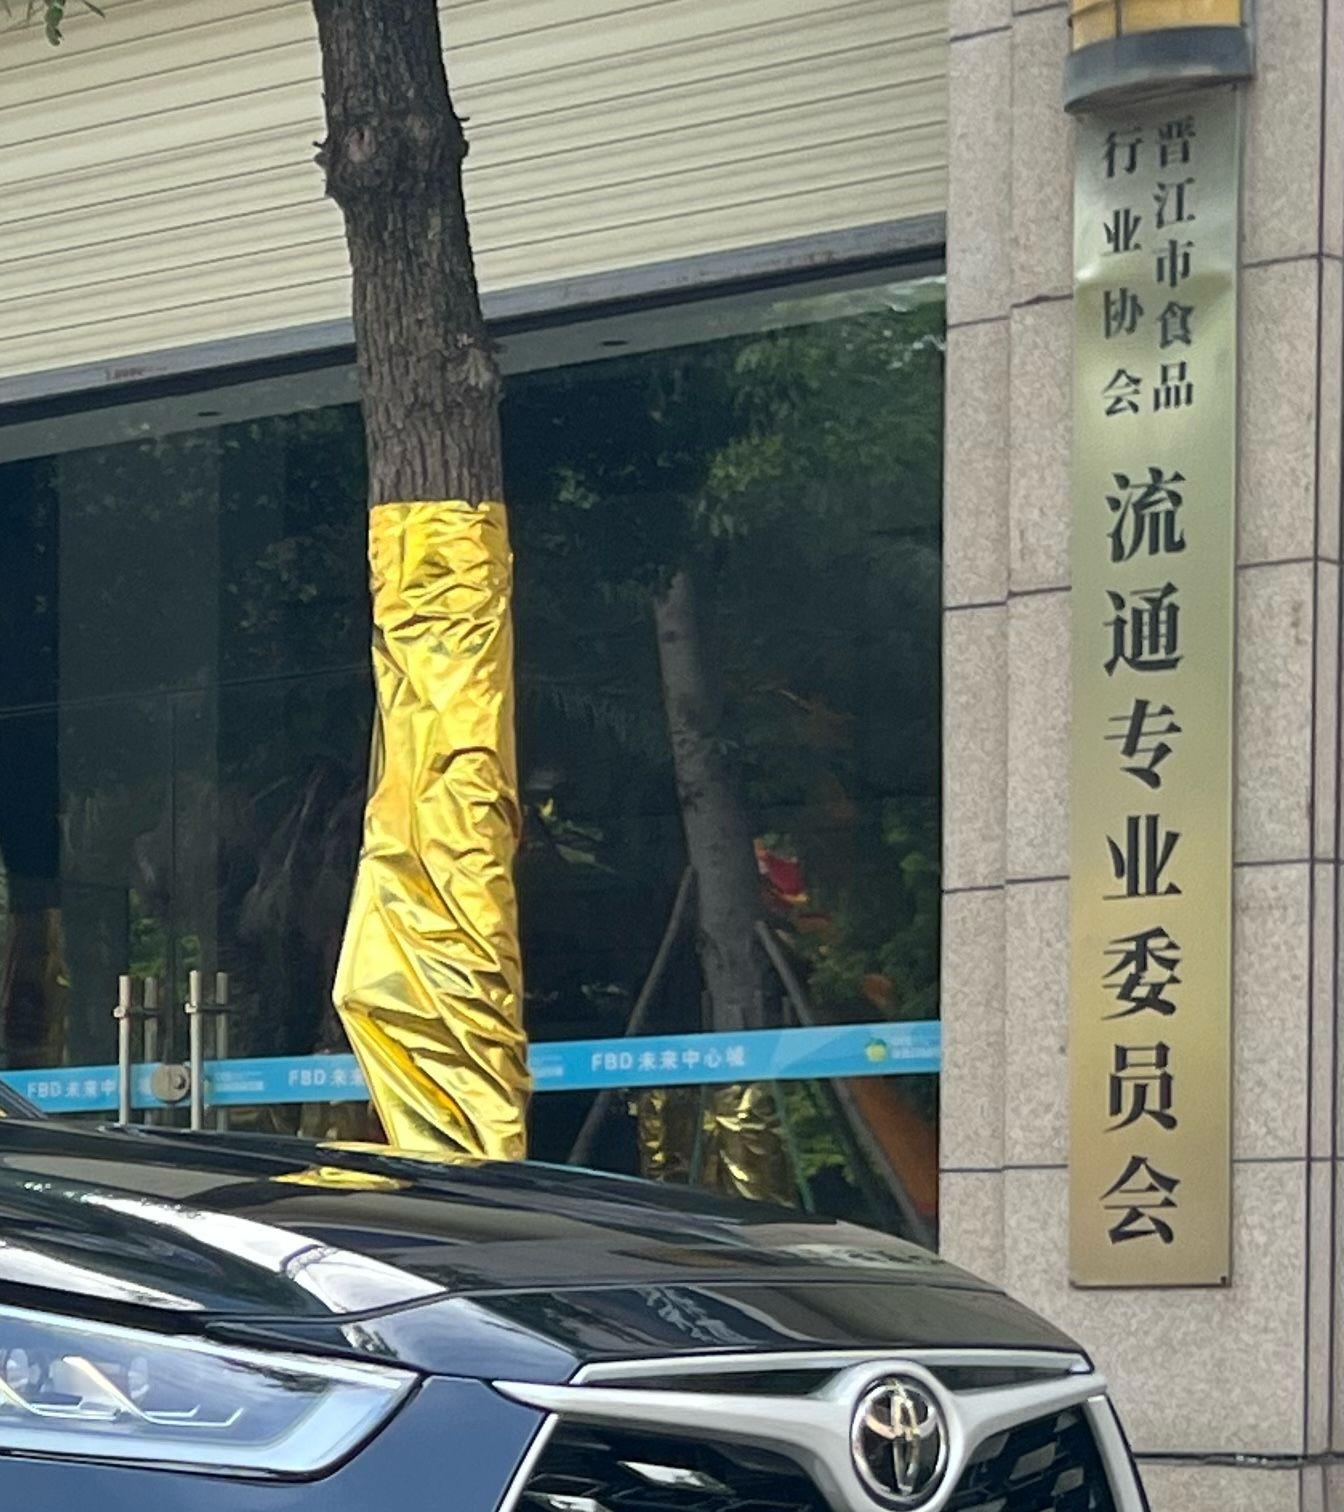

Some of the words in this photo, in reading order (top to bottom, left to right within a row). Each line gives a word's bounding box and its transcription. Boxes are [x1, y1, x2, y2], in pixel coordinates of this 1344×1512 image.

[1102, 126, 1143, 418] 行业协会
[1153, 115, 1195, 412] 晋江市食品
[1098, 466, 1186, 1245] 流通专业委员会
[26, 1081, 61, 1098] FBD
[288, 1068, 326, 1087] FBD
[590, 1051, 633, 1072] FBD
